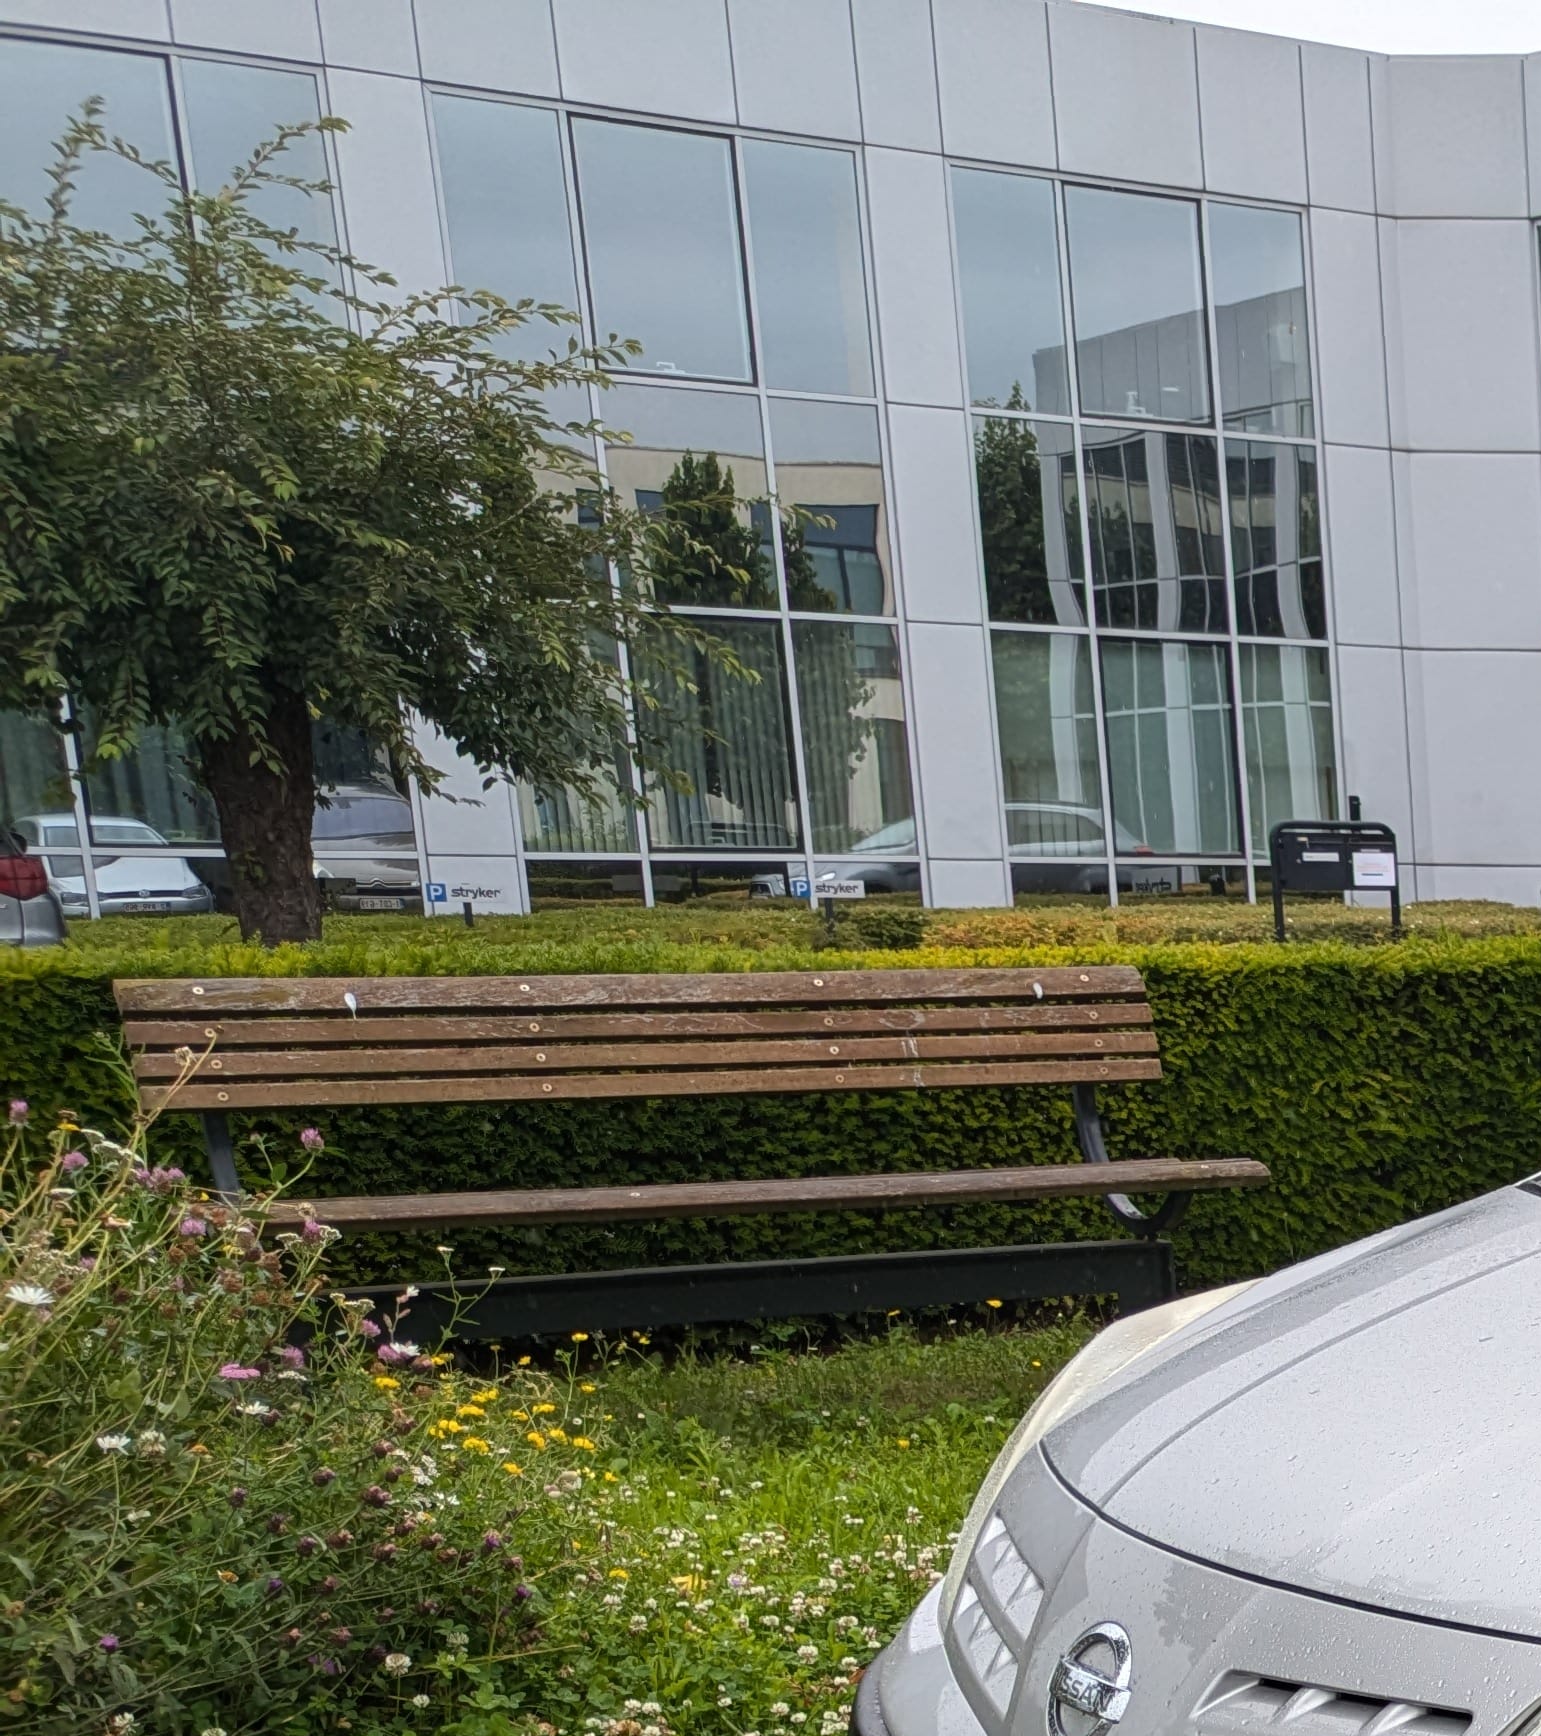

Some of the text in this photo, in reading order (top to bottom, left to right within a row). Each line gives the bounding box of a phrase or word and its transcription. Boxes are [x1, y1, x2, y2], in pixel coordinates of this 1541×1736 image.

[429, 885, 501, 900] P stryker
[796, 882, 859, 896] P stryker
